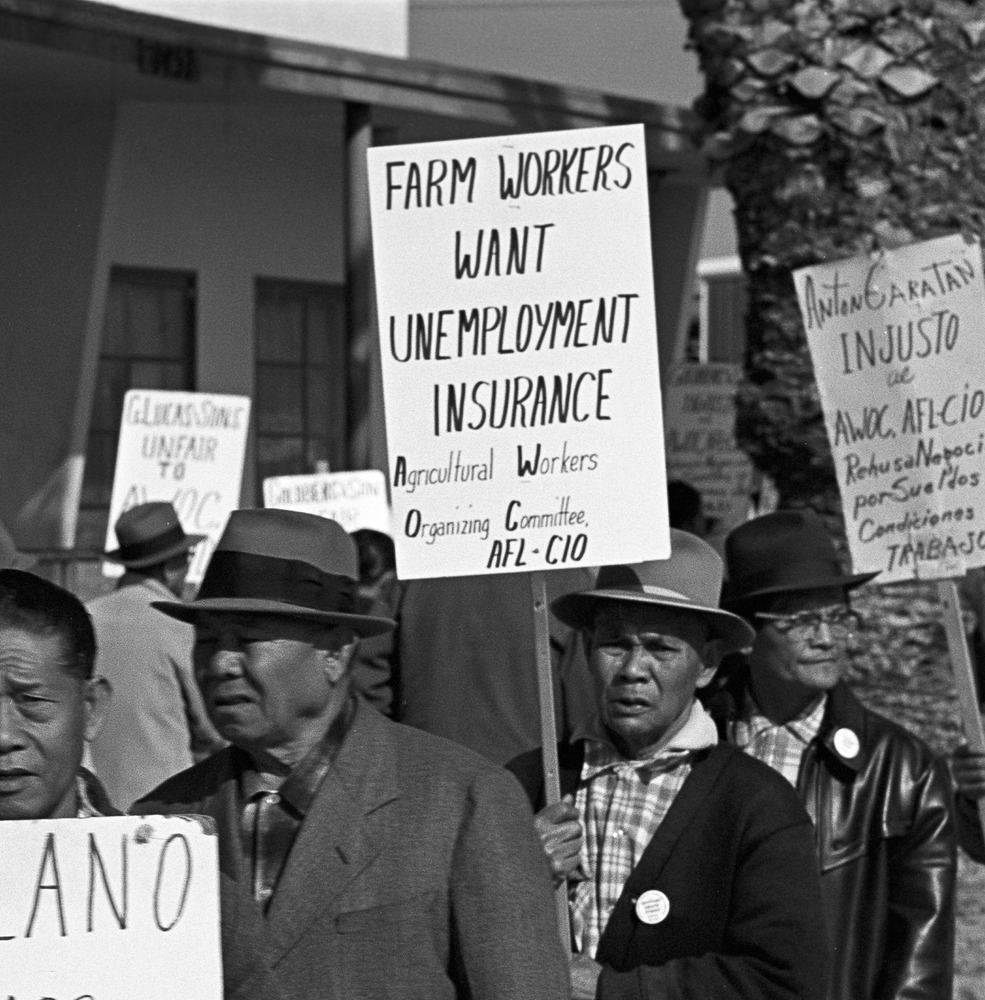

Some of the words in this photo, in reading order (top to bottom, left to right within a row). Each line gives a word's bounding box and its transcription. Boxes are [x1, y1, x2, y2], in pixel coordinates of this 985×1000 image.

[385, 156, 477, 210] FARM
[497, 142, 635, 200] WORKERS
[454, 223, 555, 279] WANT
[389, 293, 640, 362] UNEMPLOYMENT
[841, 309, 959, 375] INJUSTO
[433, 368, 613, 436] INSURANCE
[141, 434, 219, 462] UNFAIR
[158, 460, 186, 481] TO
[393, 447, 494, 493] Agricultural
[517, 441, 599, 477] Workers
[404, 504, 490, 545] Organizing
[504, 496, 590, 532] Committee,
